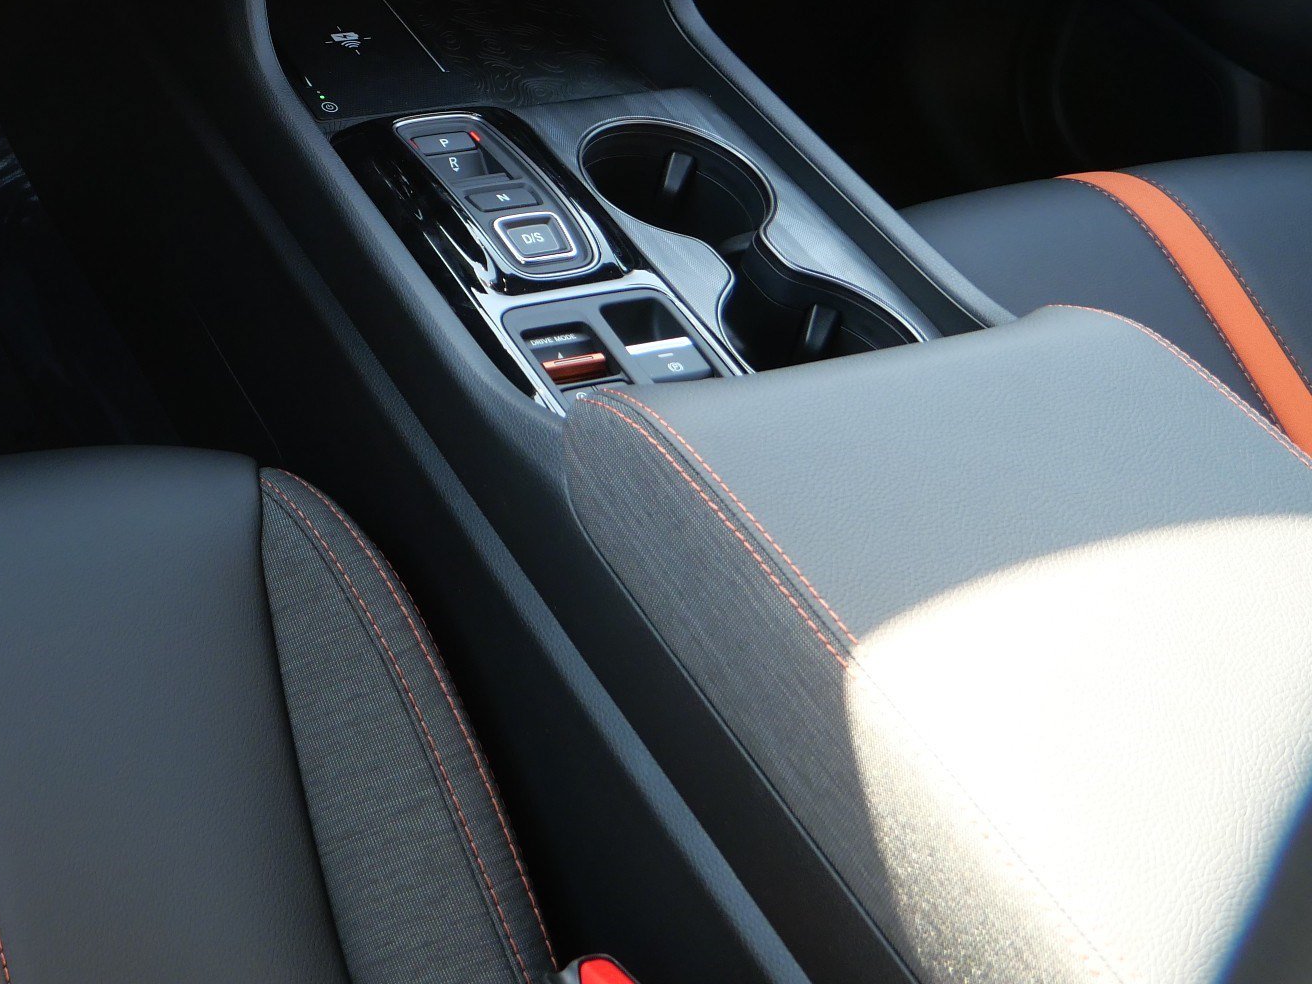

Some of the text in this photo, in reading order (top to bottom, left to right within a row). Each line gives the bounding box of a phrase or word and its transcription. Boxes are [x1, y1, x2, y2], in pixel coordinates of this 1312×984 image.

[439, 138, 449, 148] P
[448, 156, 459, 168] R
[497, 193, 510, 202] N
[521, 232, 544, 244] D/S
[530, 333, 577, 346] DRIVE MODE
